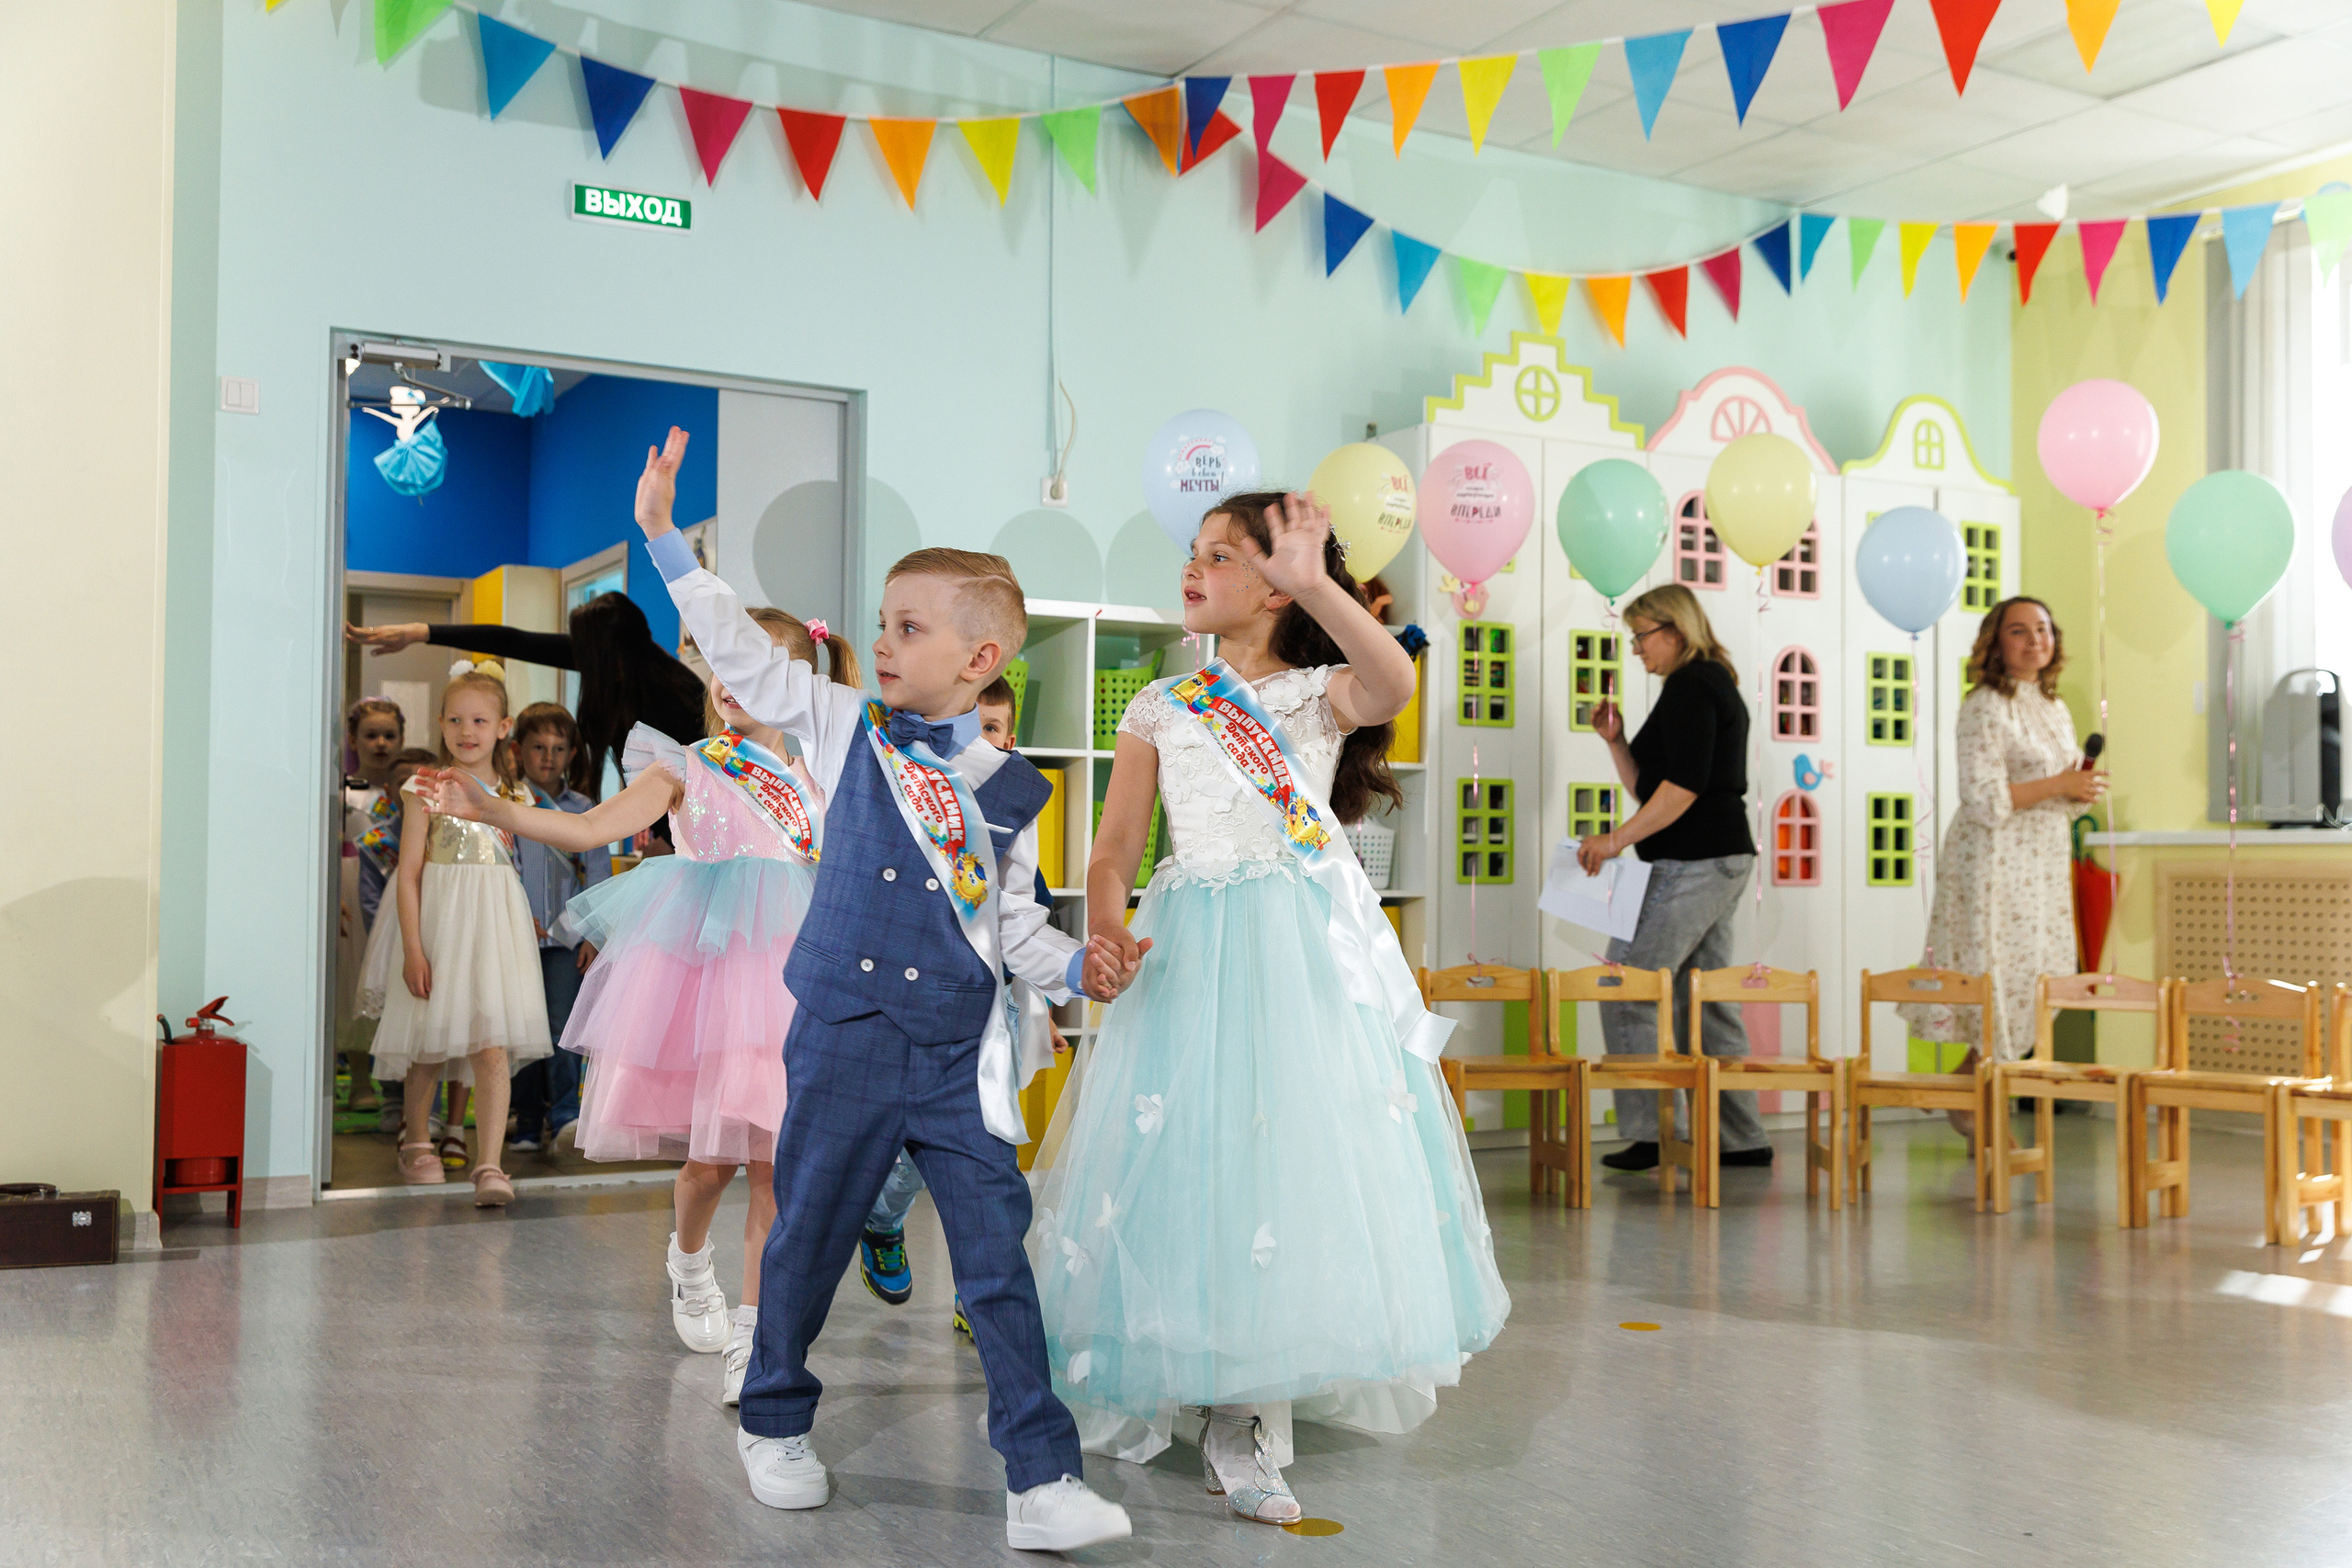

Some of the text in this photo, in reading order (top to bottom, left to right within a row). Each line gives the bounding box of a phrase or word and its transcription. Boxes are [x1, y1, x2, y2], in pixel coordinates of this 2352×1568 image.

[585, 188, 683, 226] ВЫХОД
[1217, 701, 1292, 788] ВЫПУСКНИК
[1225, 721, 1268, 774] Детского
[1227, 742, 1250, 768] сада
[751, 766, 810, 840] ВЫПУСКНИК
[760, 784, 797, 827] Детского
[763, 799, 784, 820] сада
[904, 761, 944, 823] Детского
[904, 784, 925, 813] сада
[922, 764, 964, 841] ПУСКНИК
